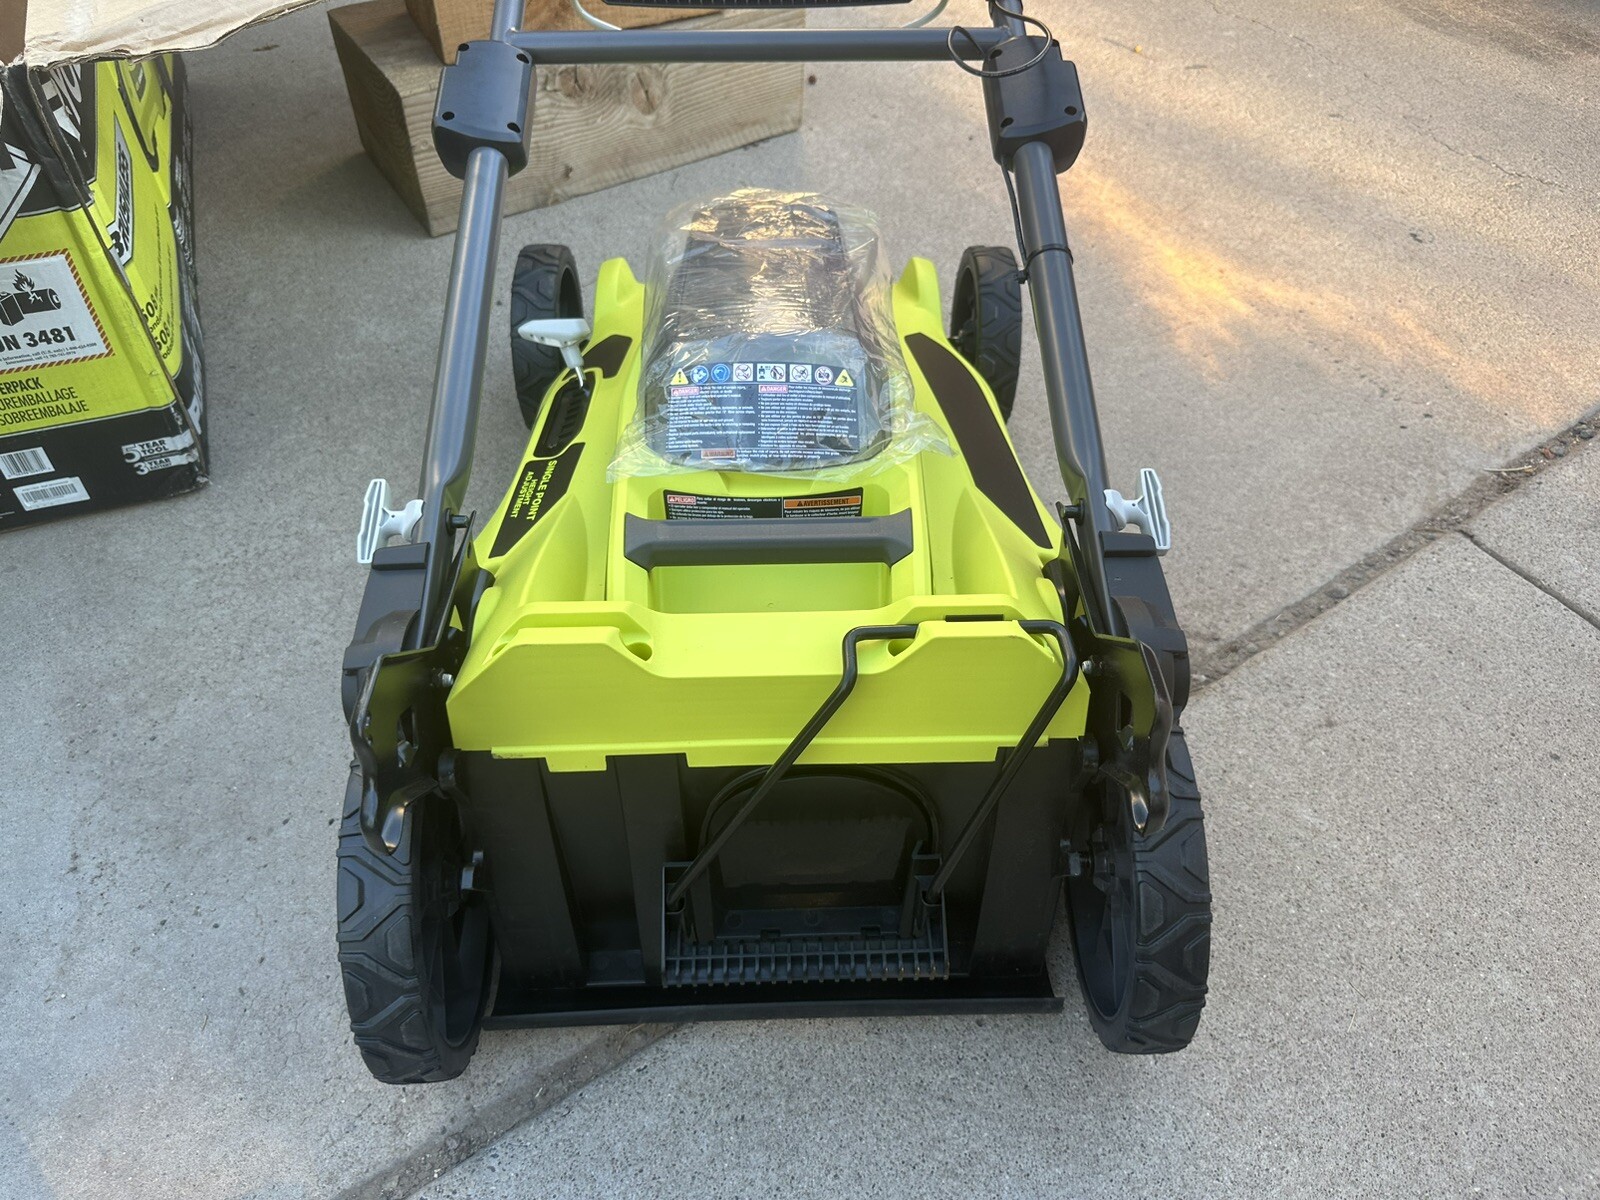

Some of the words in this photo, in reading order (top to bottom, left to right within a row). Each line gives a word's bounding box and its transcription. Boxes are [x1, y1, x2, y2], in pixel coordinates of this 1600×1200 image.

[23, 326, 76, 348] 3481
[0, 400, 89, 426] SOBREEMBALAJE
[121, 443, 141, 463] 5
[138, 439, 166, 450] YEAR
[141, 446, 169, 455] TOOL
[133, 462, 149, 475] 3
[147, 458, 171, 466] YEAR
[538, 460, 557, 491] SINGLE
[510, 471, 534, 518] ADJUSTMENT
[523, 479, 538, 505] HEIGHT
[803, 498, 849, 507] AVERTISSEMENT
[526, 492, 544, 520] POINT
